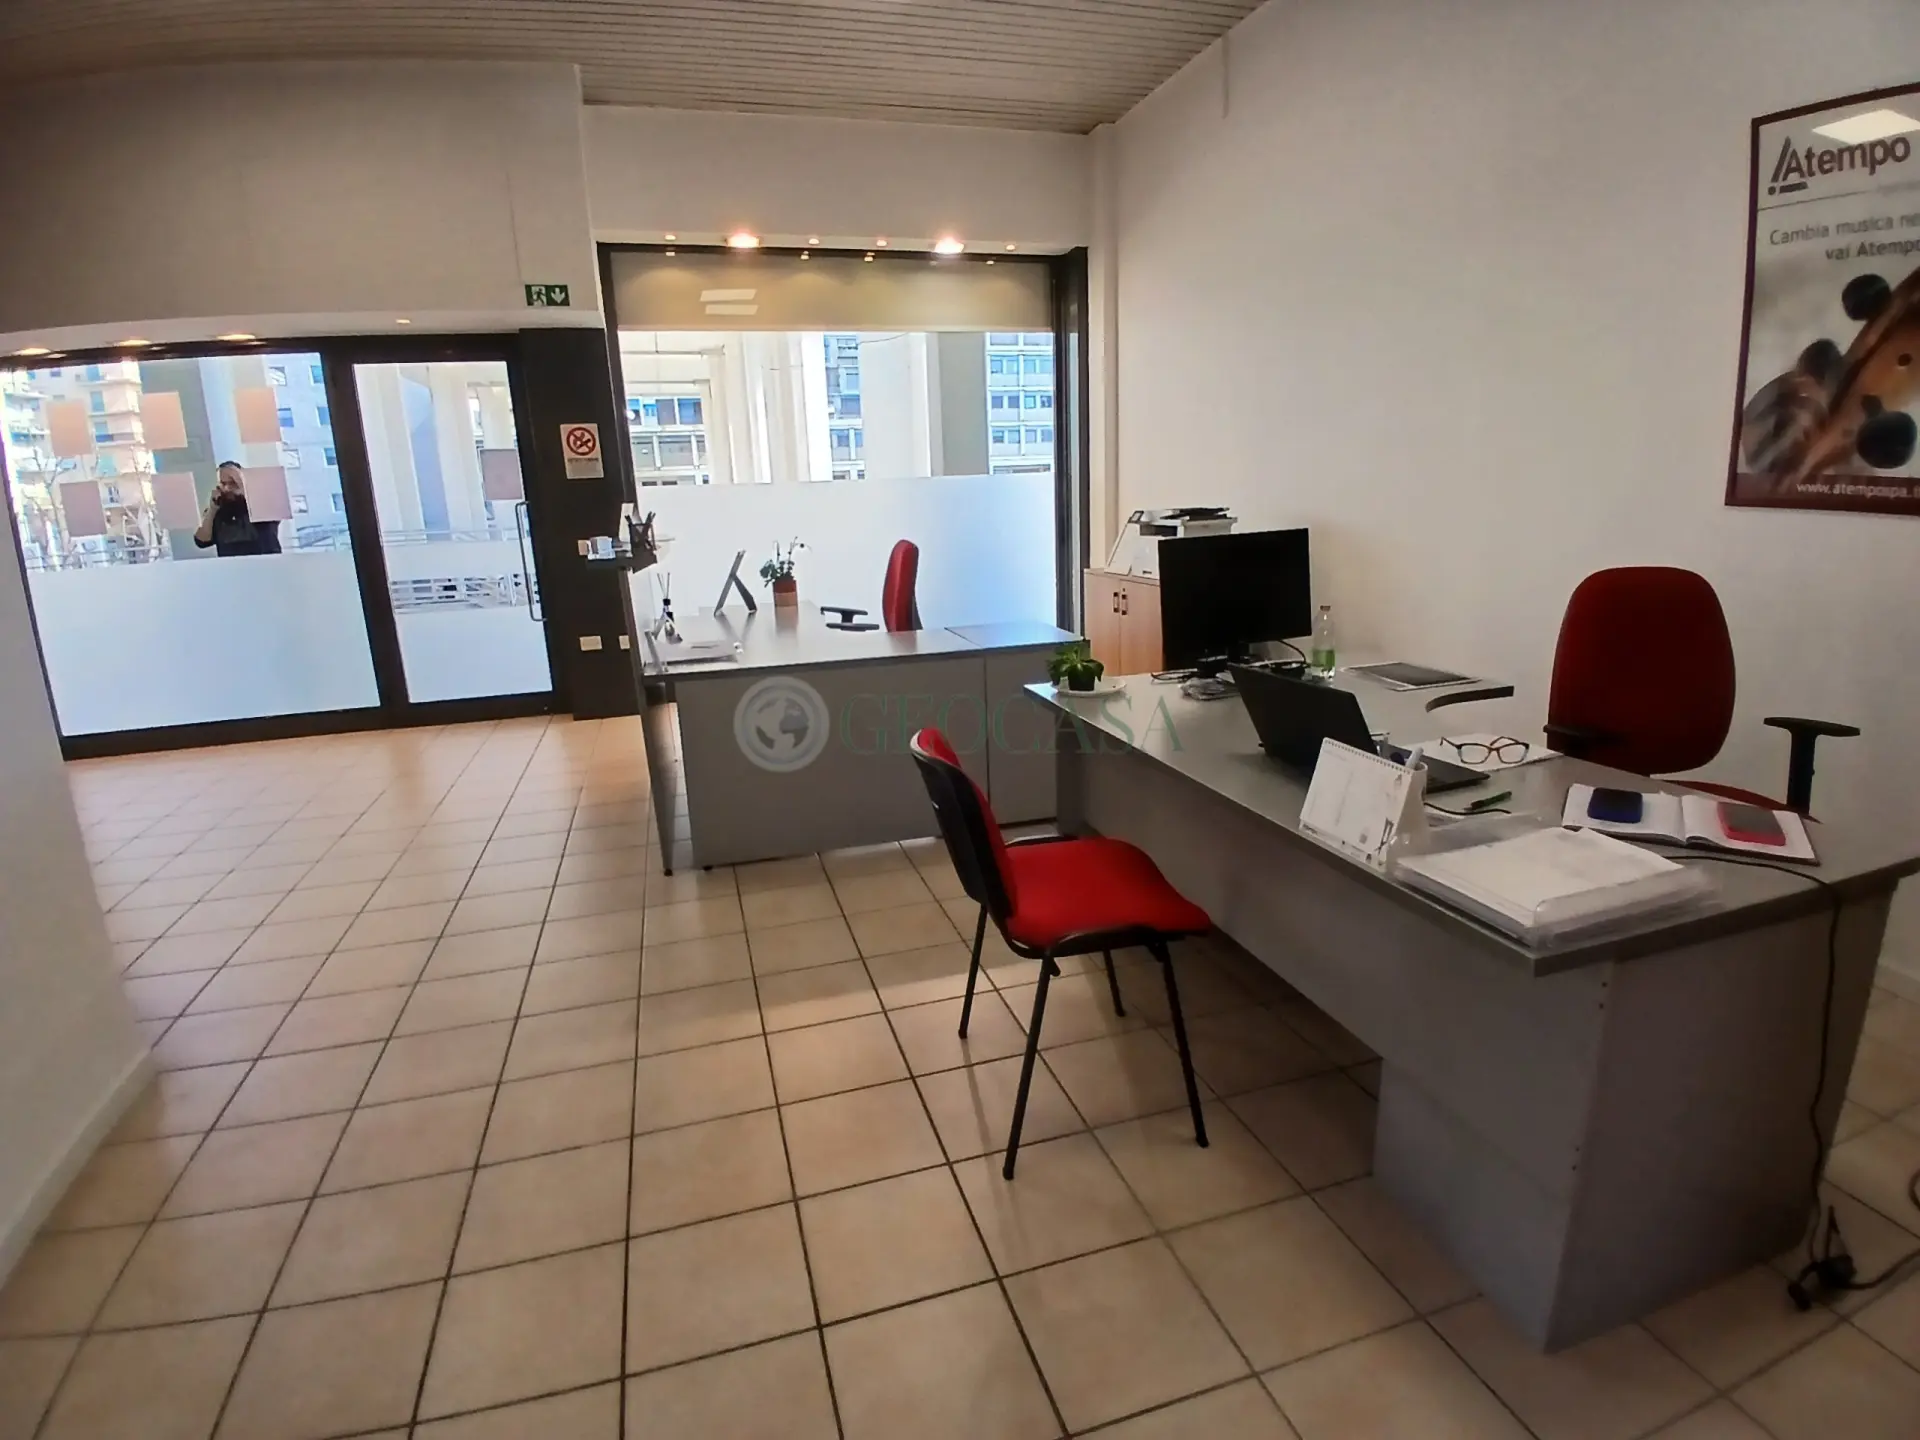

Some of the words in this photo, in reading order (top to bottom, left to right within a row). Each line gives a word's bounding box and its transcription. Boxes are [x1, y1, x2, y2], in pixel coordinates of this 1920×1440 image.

[1770, 136, 1911, 185] Atempo
[1769, 224, 1829, 246] Cambia
[1836, 215, 1894, 235] musica
